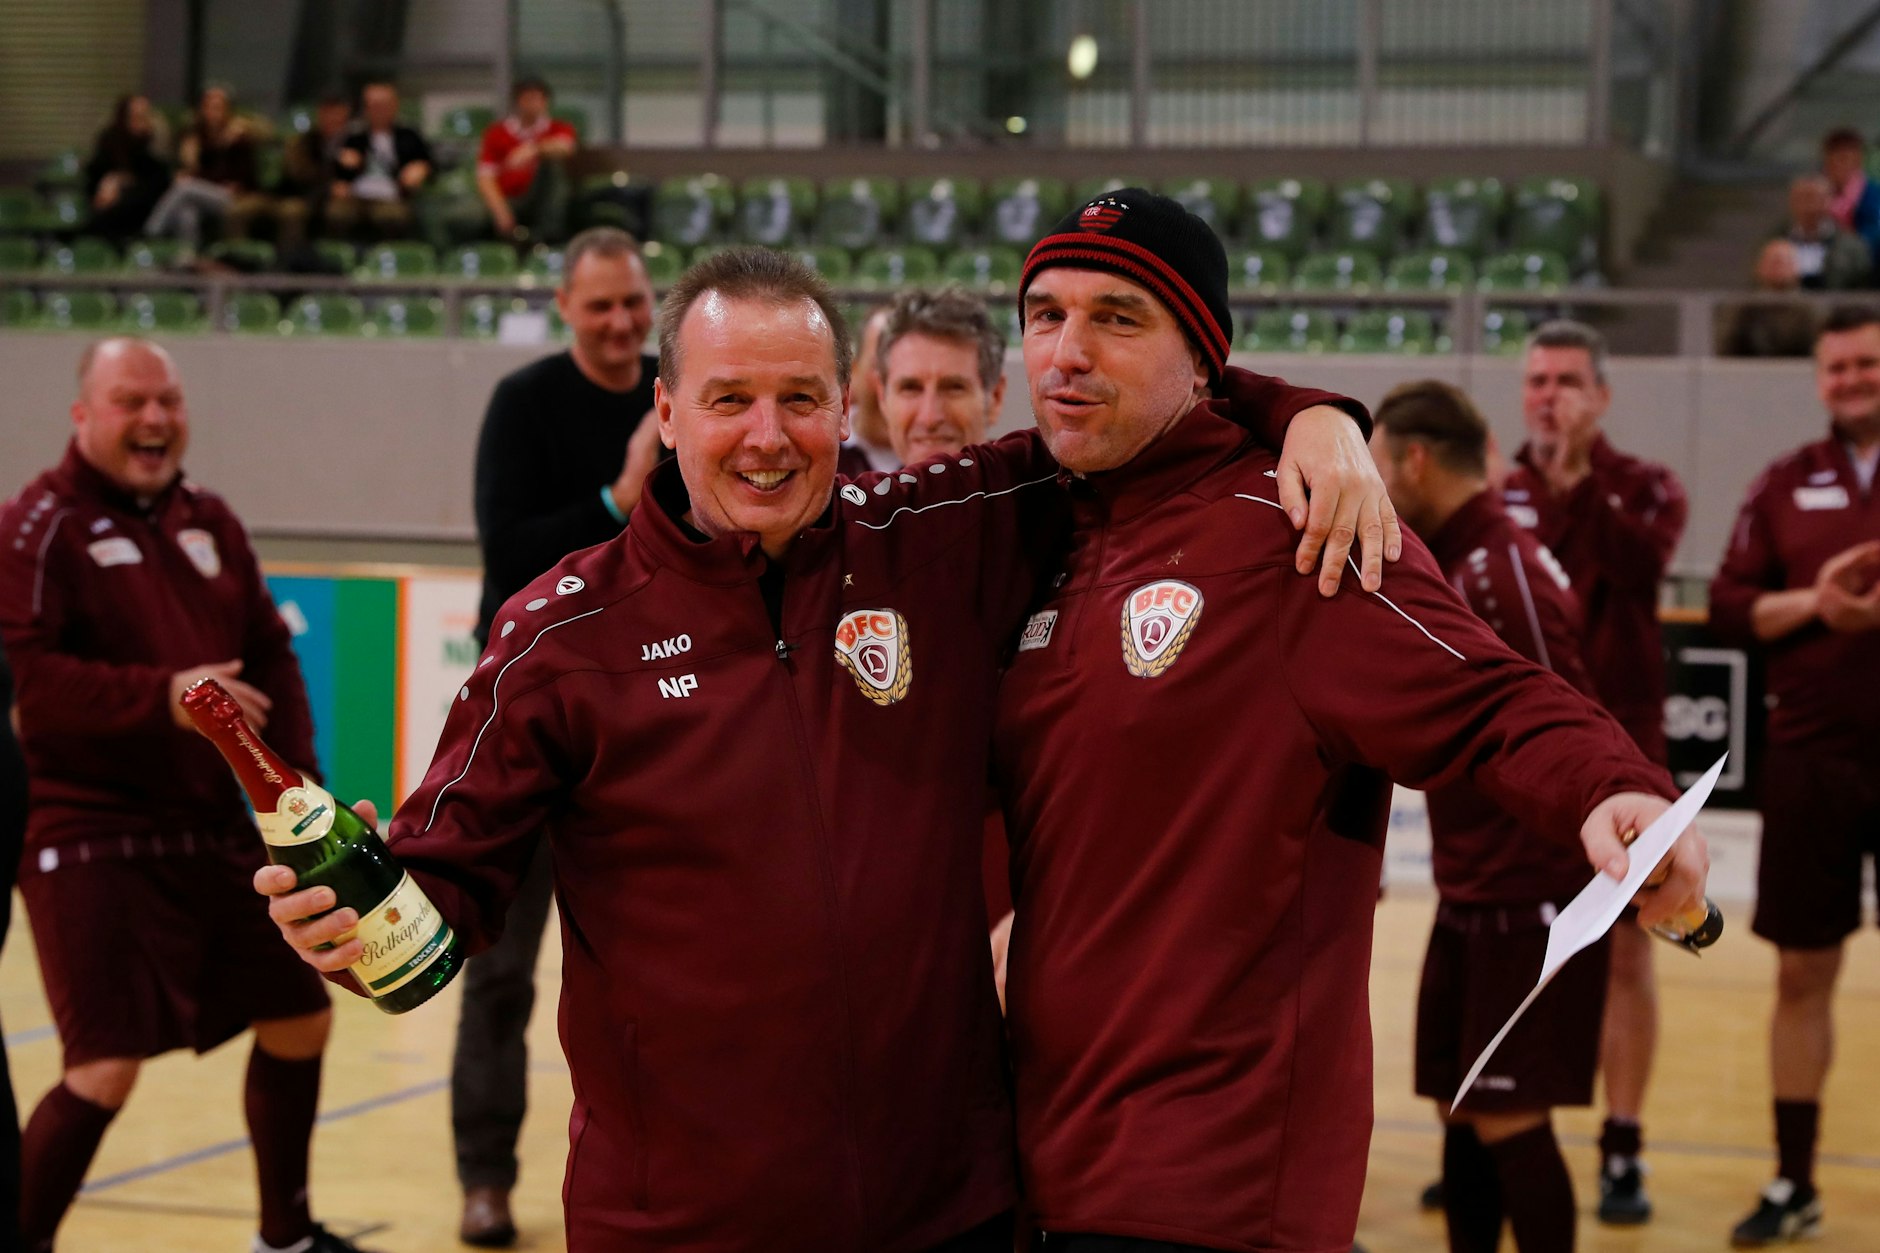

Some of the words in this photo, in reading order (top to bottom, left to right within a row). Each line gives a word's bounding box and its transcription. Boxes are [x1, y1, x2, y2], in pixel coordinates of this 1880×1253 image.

[1135, 586, 1194, 615] BFC
[836, 614, 893, 648] BFC
[640, 633, 692, 661] JAKO
[657, 673, 698, 698] NP
[360, 899, 432, 966] Rotkäppche
[408, 941, 438, 968] TROCKEN
